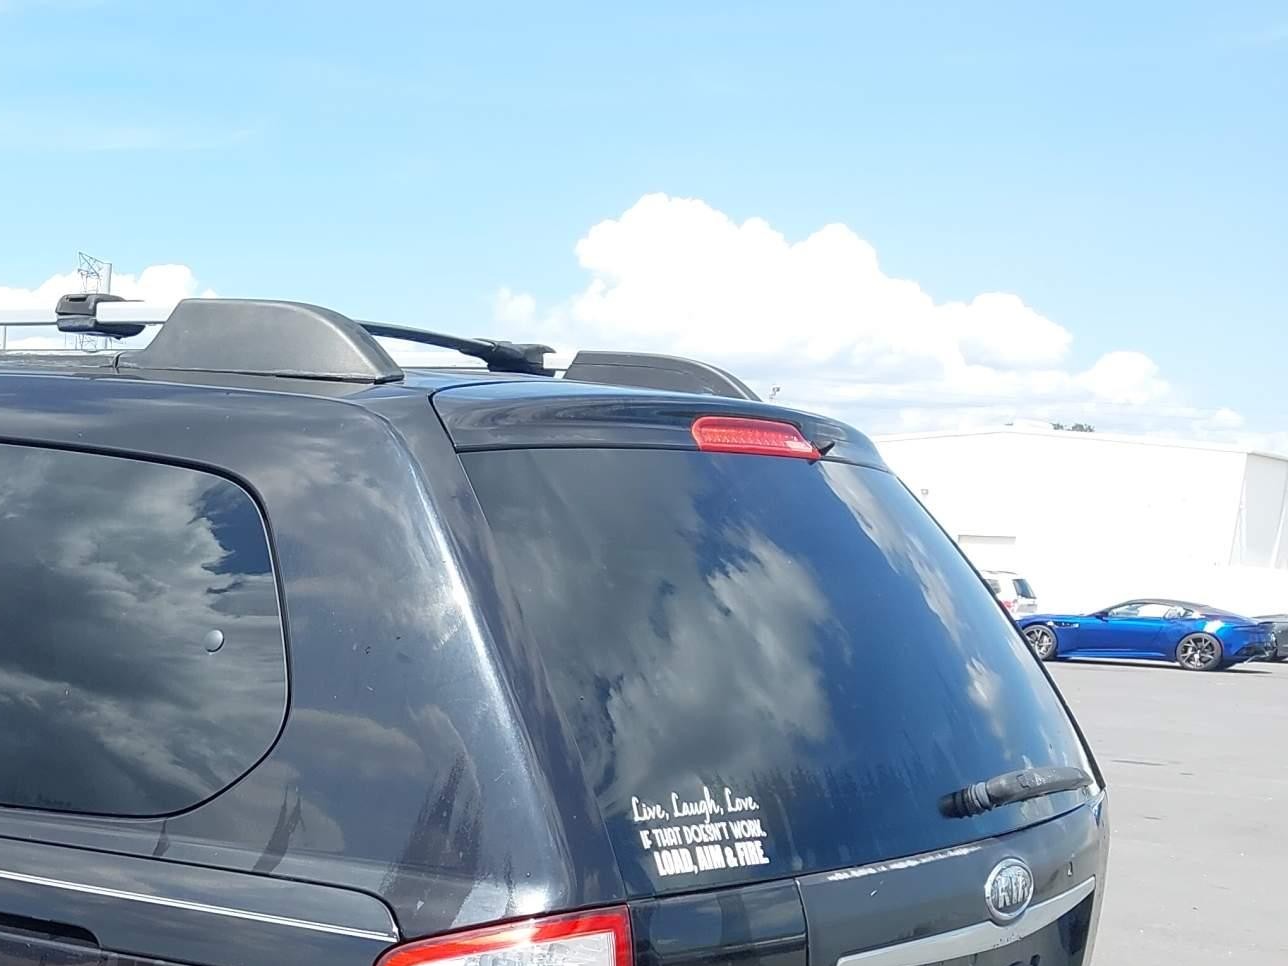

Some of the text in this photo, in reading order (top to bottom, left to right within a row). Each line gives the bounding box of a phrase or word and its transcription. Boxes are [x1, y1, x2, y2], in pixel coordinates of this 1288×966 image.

[631, 786, 760, 823] Live, Laugh, Love.
[639, 829, 652, 850] IF
[652, 826, 683, 848] THAT
[683, 821, 730, 845] DOESN'T
[653, 848, 698, 877] LOAD,
[695, 843, 725, 872] AIM
[723, 845, 738, 869] &
